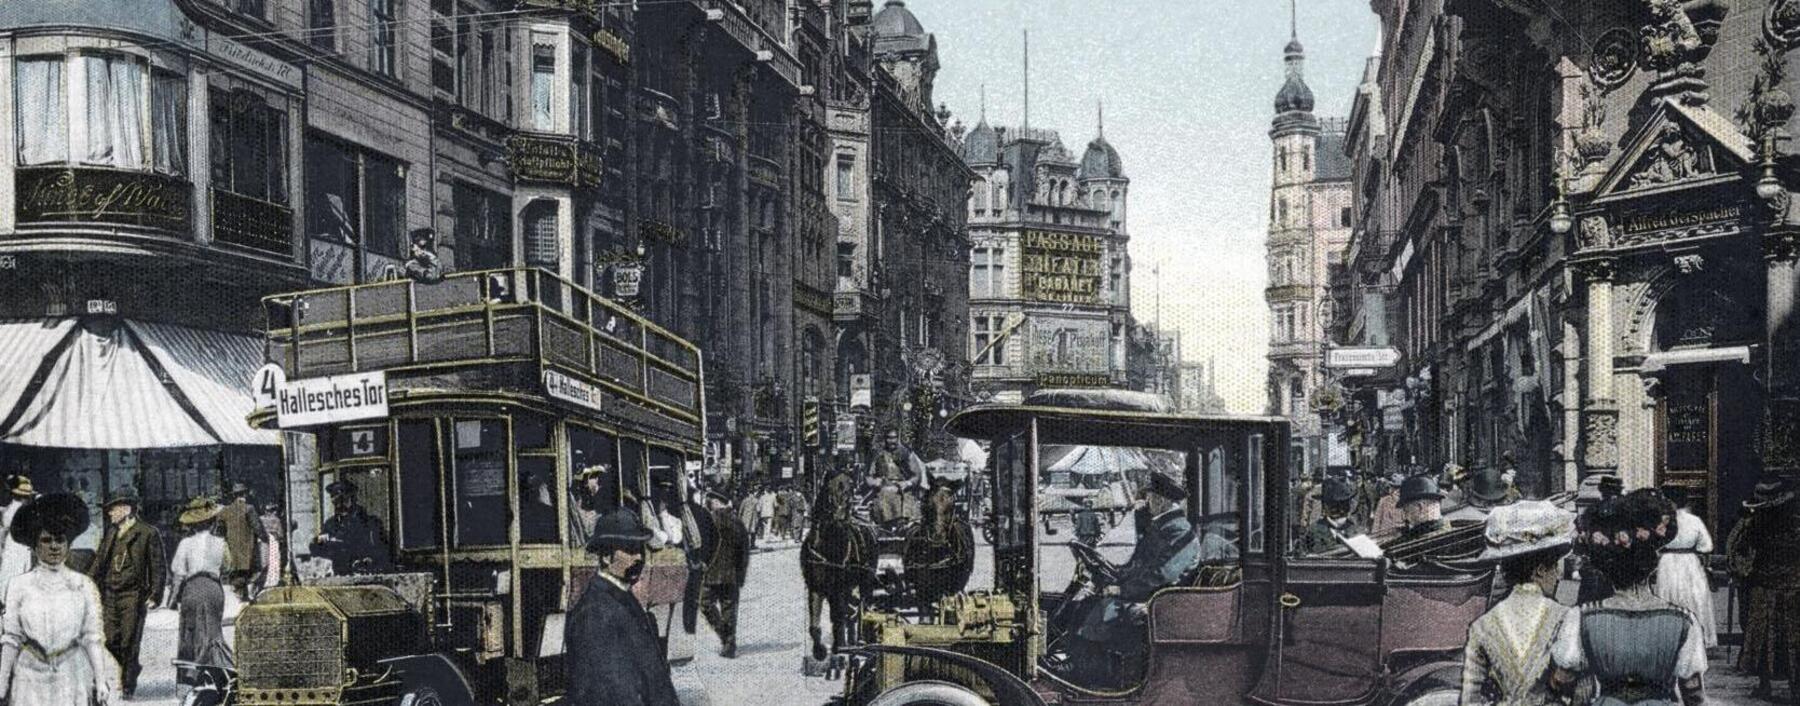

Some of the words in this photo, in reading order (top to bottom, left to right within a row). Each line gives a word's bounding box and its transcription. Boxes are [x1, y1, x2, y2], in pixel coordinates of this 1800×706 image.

[1628, 212, 1668, 232] Alfred
[1027, 230, 1103, 252] PASSAGE
[616, 272, 638, 284] BOLS
[1038, 276, 1093, 294] CABARET
[261, 369, 277, 400] 4
[549, 371, 558, 394] 4
[281, 383, 361, 415] Hallesches
[361, 379, 384, 406] Tor
[355, 432, 374, 453] 4
